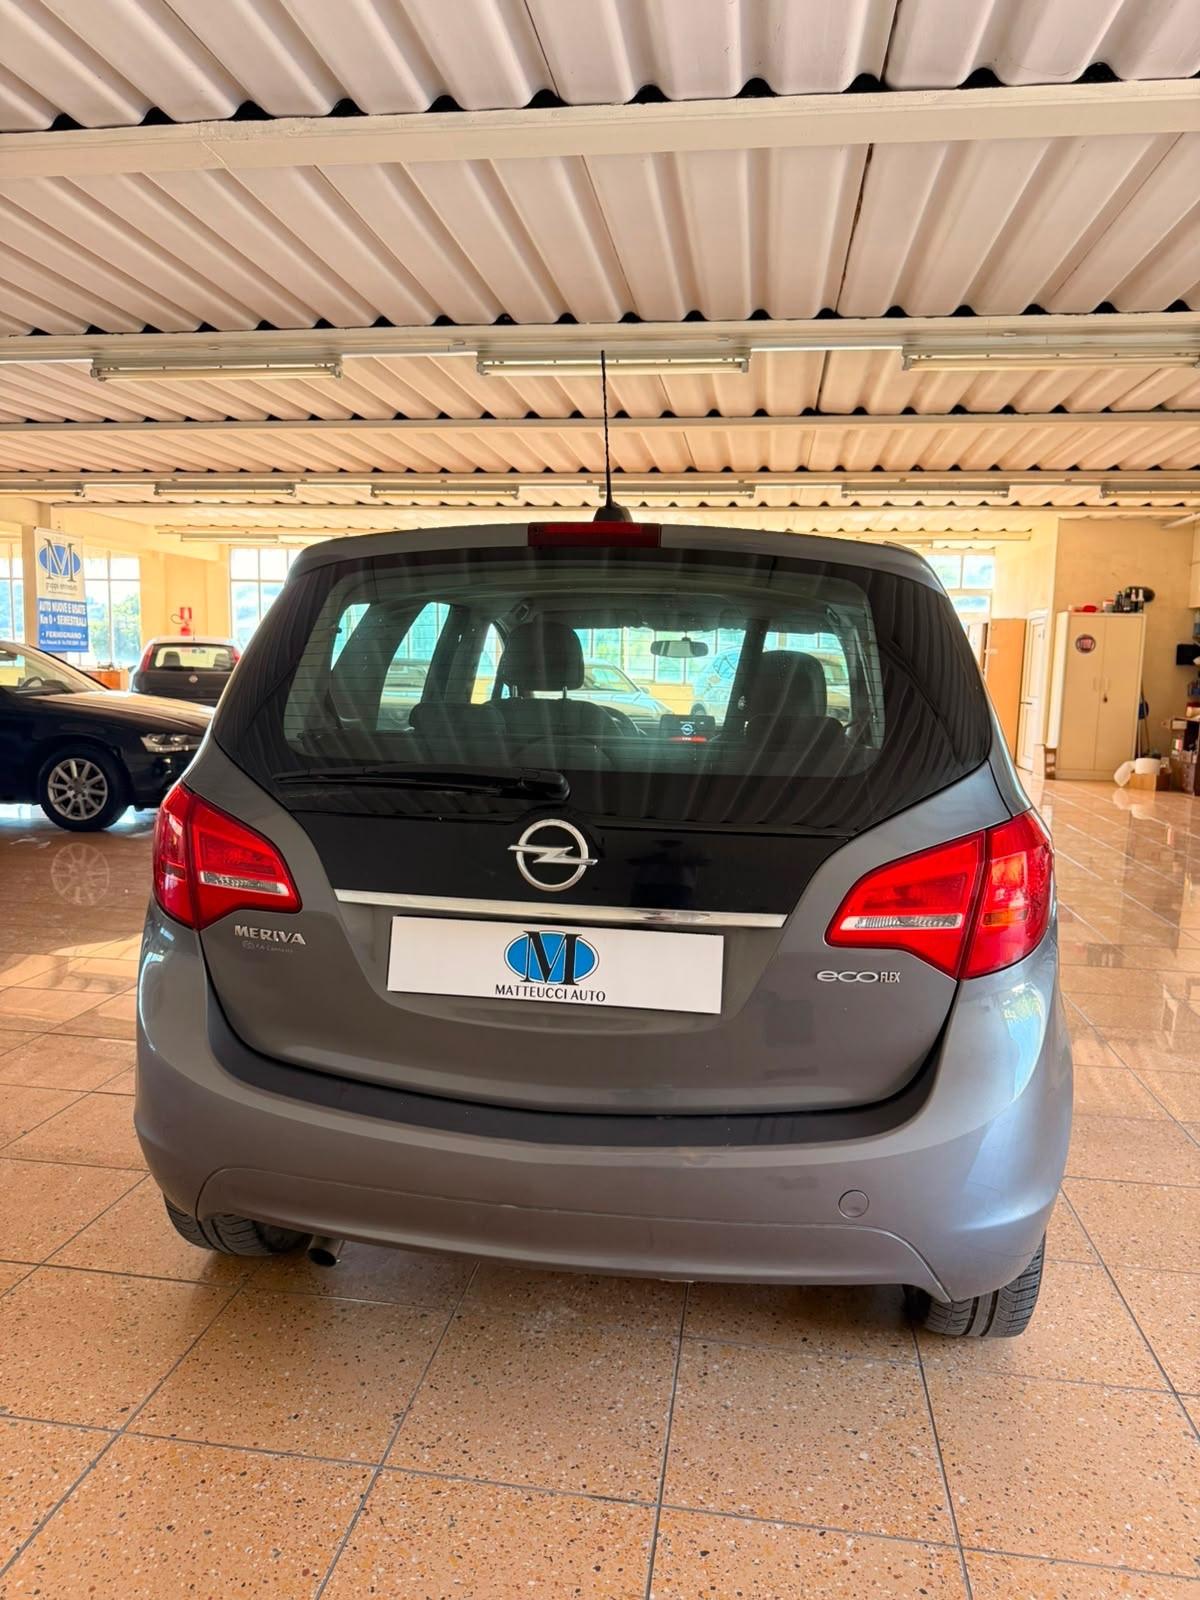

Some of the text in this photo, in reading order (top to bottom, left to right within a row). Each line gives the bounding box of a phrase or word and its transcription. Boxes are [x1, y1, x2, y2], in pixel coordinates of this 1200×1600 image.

[44, 538, 77, 582] M
[234, 924, 306, 945] MERIVA
[520, 931, 582, 985] M
[495, 984, 606, 1003] MATTEUCCI AUTO
